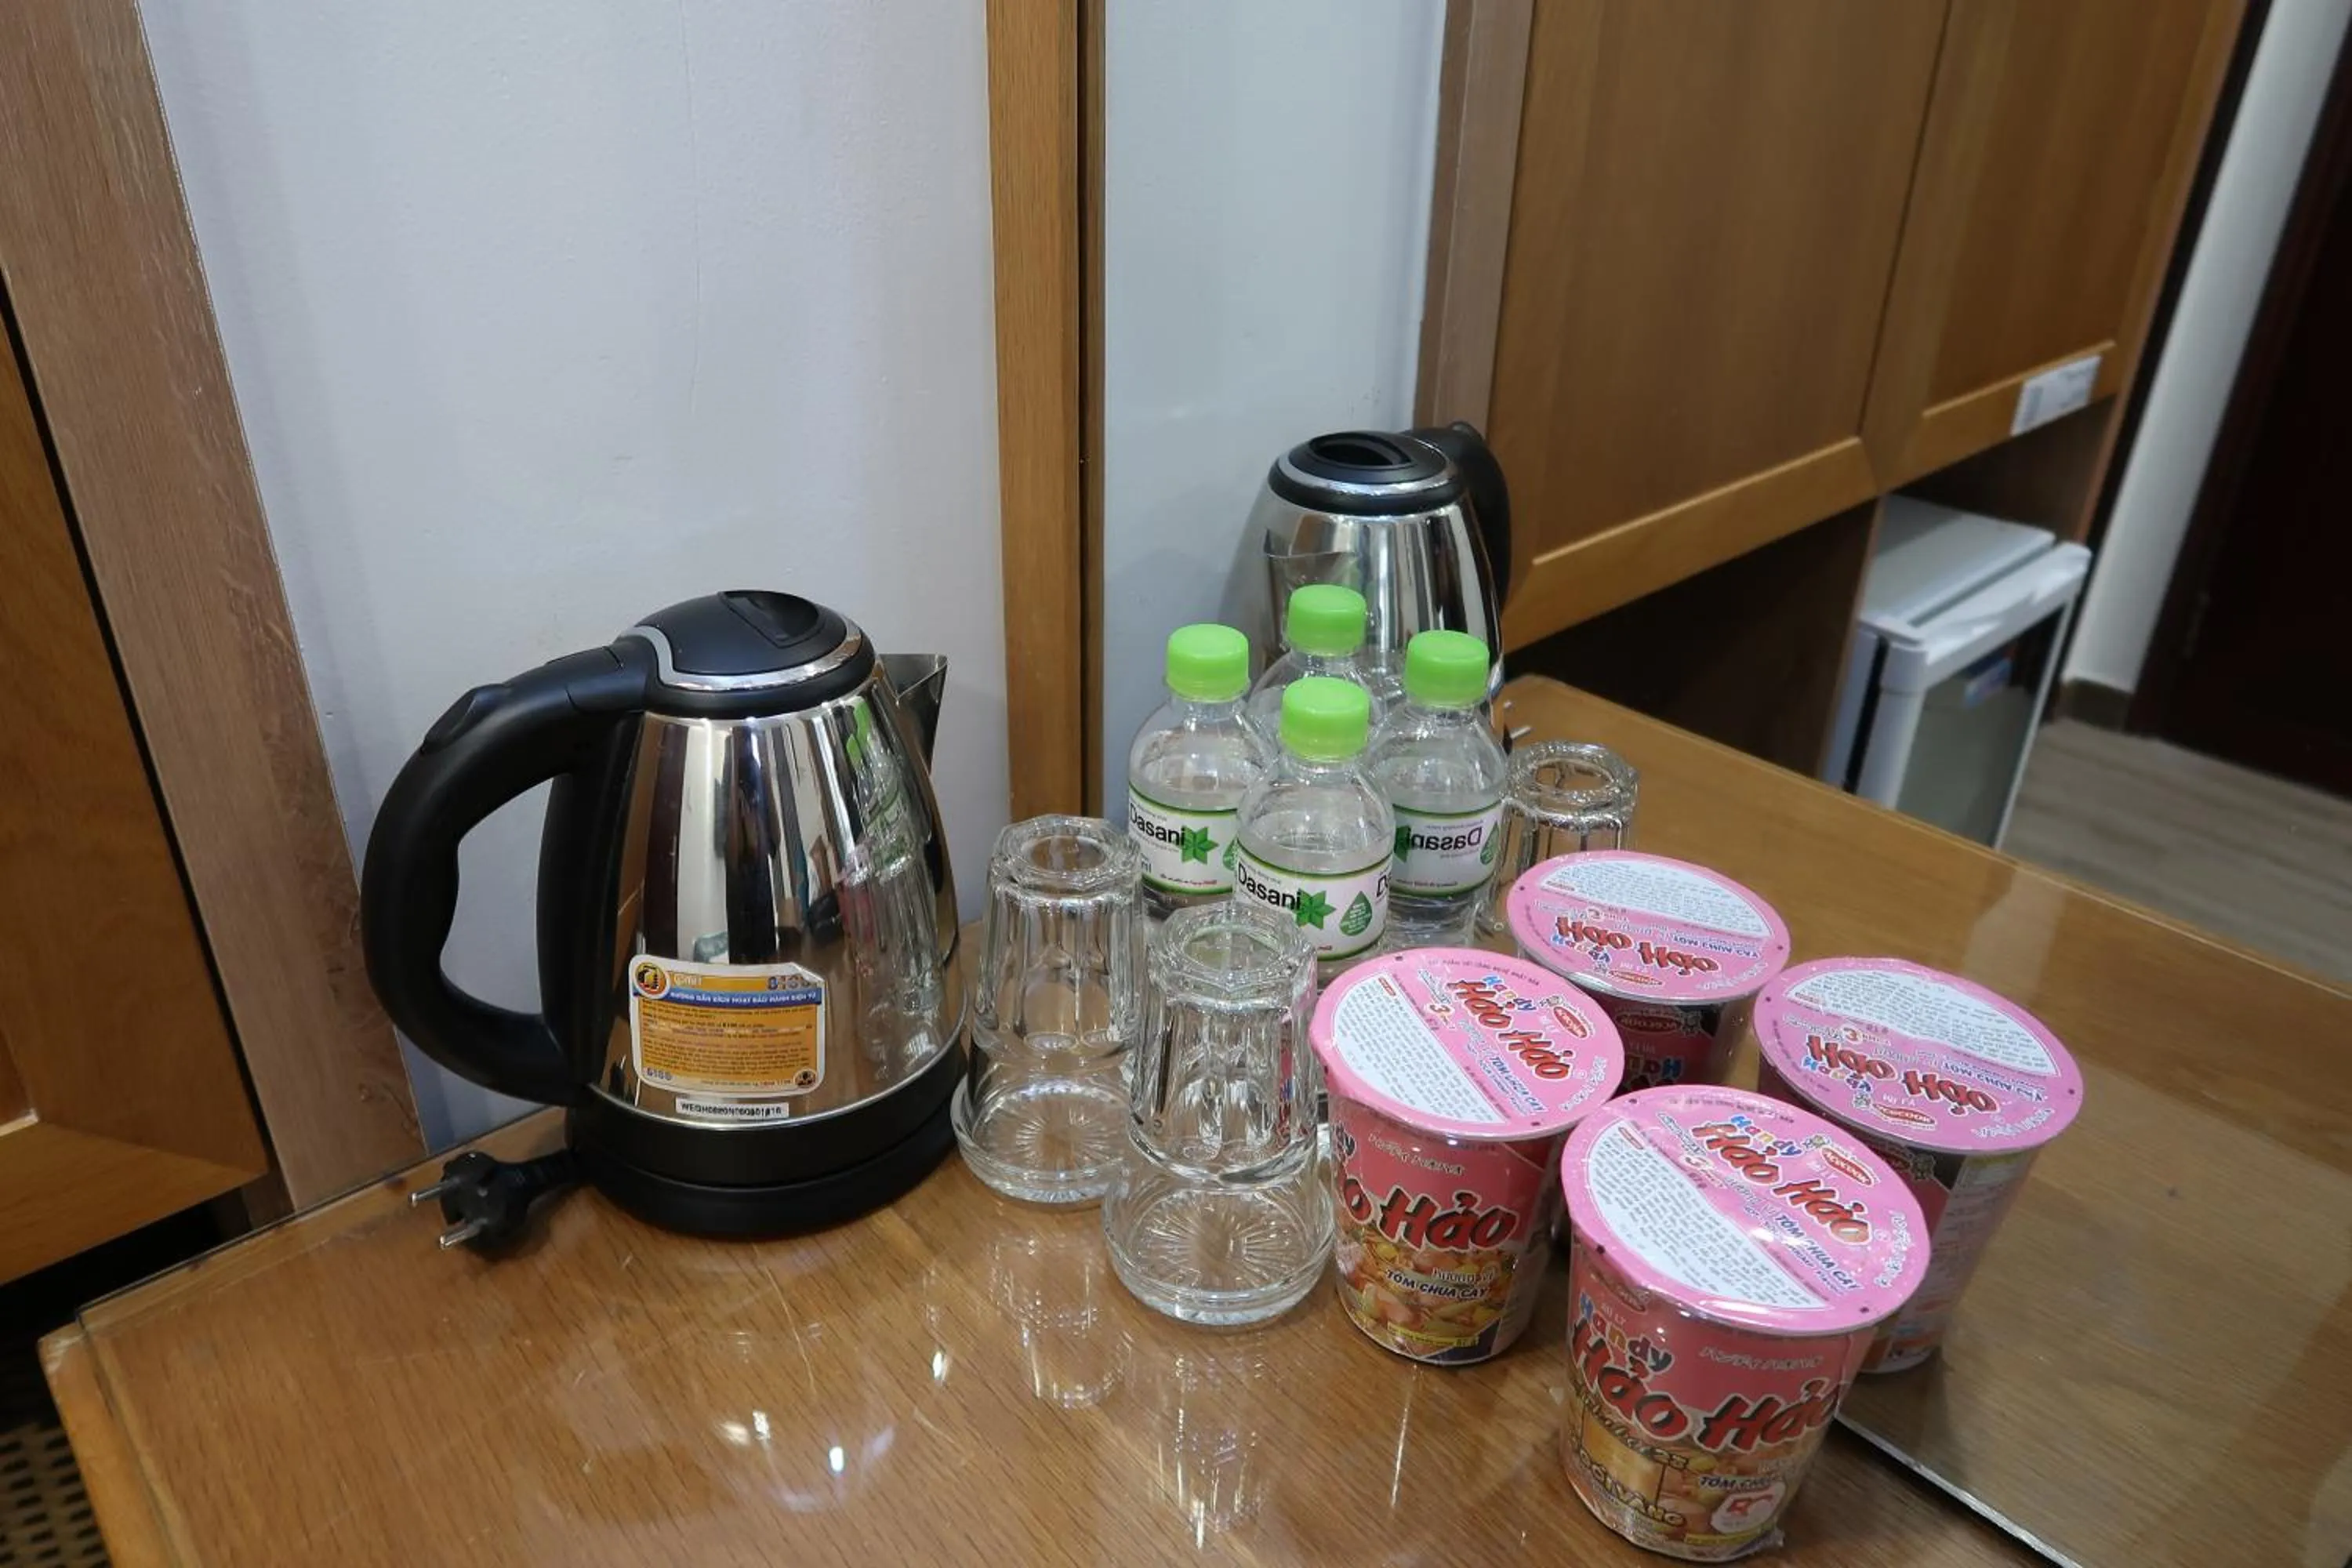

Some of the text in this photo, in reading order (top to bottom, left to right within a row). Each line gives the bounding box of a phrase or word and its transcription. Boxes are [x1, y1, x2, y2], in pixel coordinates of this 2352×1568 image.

[1130, 803, 1185, 846] Dasani
[1238, 862, 1301, 910] Dasani
[1482, 976, 1537, 1011] Handy
[1446, 980, 1515, 1029] Hảo
[1498, 1030, 1574, 1080] Hảo
[1730, 1115, 1802, 1156] Handy
[1692, 1123, 1780, 1183] Hảo
[1773, 1179, 1870, 1244] Hảo
[1379, 1187, 1519, 1250] Hảo
[1419, 1283, 1457, 1298] CHUA
[1459, 1287, 1489, 1298] CAY
[1579, 1294, 1673, 1371] Handy
[1573, 1317, 1689, 1437] Hảo
